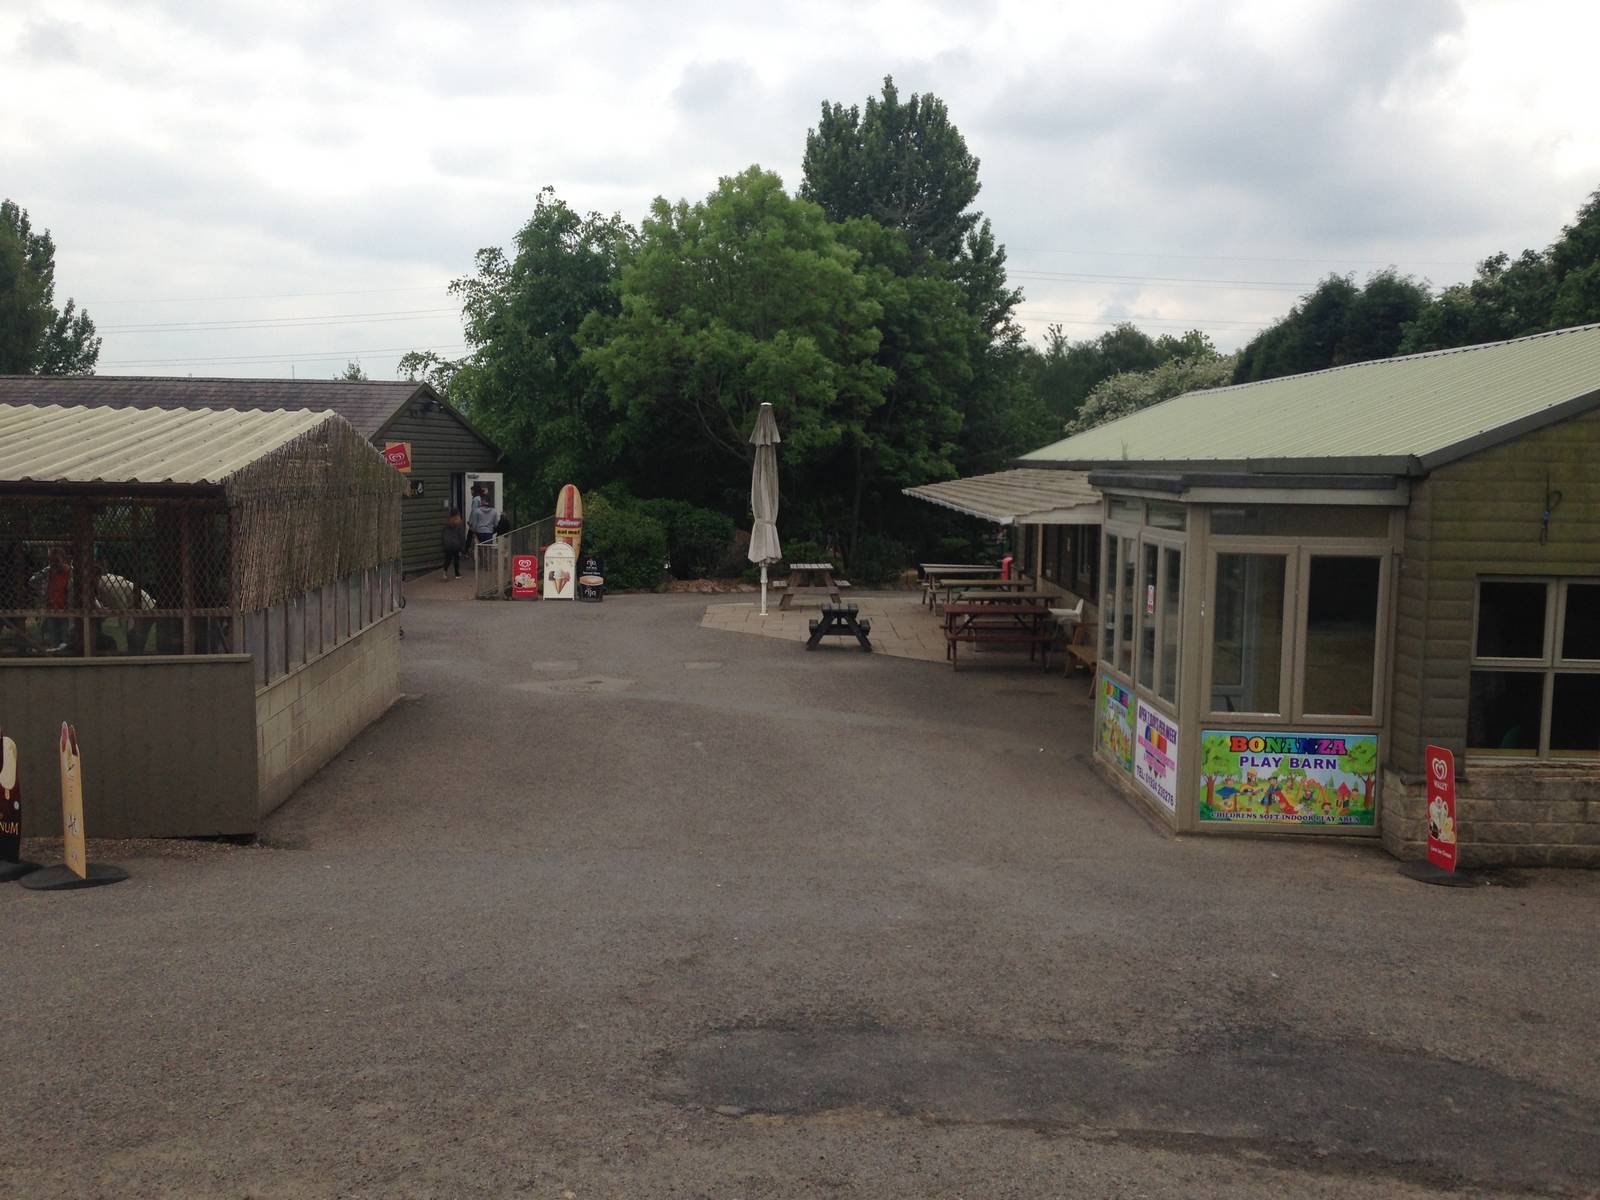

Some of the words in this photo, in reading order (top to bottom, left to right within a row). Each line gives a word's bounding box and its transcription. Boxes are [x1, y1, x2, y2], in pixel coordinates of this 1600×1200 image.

[1230, 736, 1348, 755] BONANZA
[1239, 756, 1282, 768] PLAY
[1289, 757, 1337, 770] BARN
